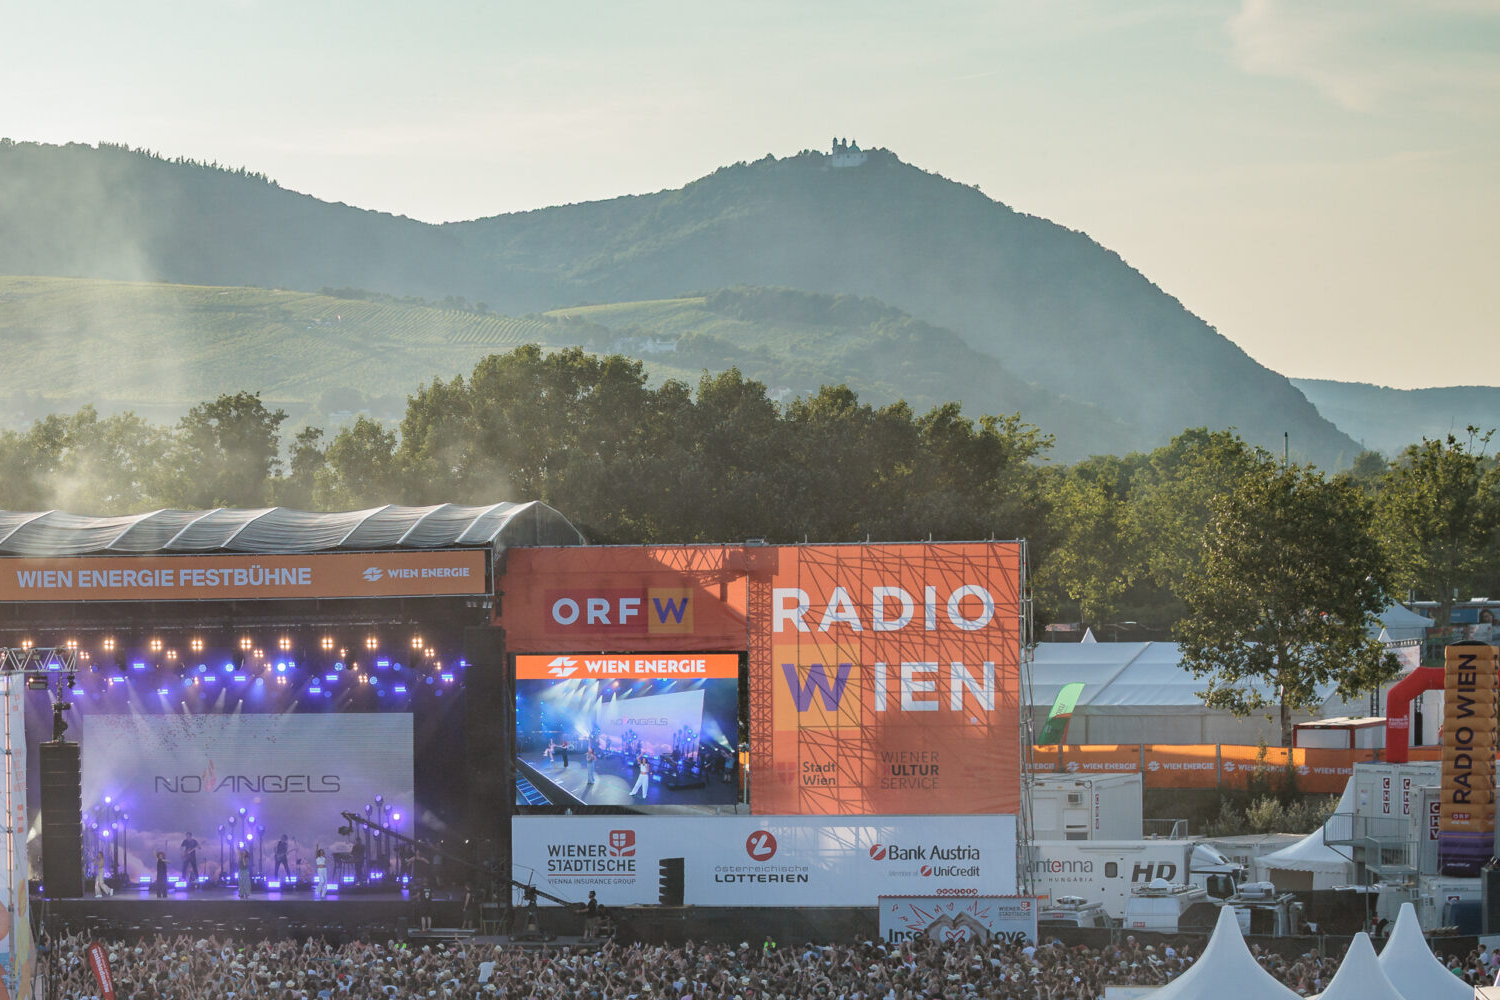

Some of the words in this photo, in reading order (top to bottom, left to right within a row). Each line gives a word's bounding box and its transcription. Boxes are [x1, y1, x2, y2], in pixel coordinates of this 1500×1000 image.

[16, 570, 73, 588] WIEN
[78, 569, 175, 588] ENERGIE
[179, 564, 312, 587] FESTBÜHNE
[388, 568, 418, 579] WIEN
[421, 567, 470, 578] ENERGIE
[552, 598, 641, 625] ORF
[652, 597, 689, 624] W
[772, 585, 995, 633] RADIO
[584, 660, 630, 674] WIEN
[634, 660, 706, 673] ENERGIE
[781, 661, 995, 712] WIEN
[1456, 654, 1477, 719] WIEN
[881, 752, 939, 763] WIENER
[803, 761, 836, 773] Stadt
[1453, 726, 1474, 804] RADIO
[155, 775, 202, 793] NO
[214, 775, 340, 793] ANGELS
[803, 774, 836, 786] Wien
[881, 777, 939, 790] SERVICE
[547, 845, 607, 857] WIENER
[889, 844, 926, 861] Bank
[930, 844, 980, 861] Austria
[547, 858, 636, 872] STÄDTISCHE
[715, 864, 809, 872] österreichische
[933, 865, 980, 877] UniCredit
[1026, 859, 1093, 873] antenna
[1131, 861, 1177, 883] HD
[715, 873, 809, 883] LOTTERIEN
